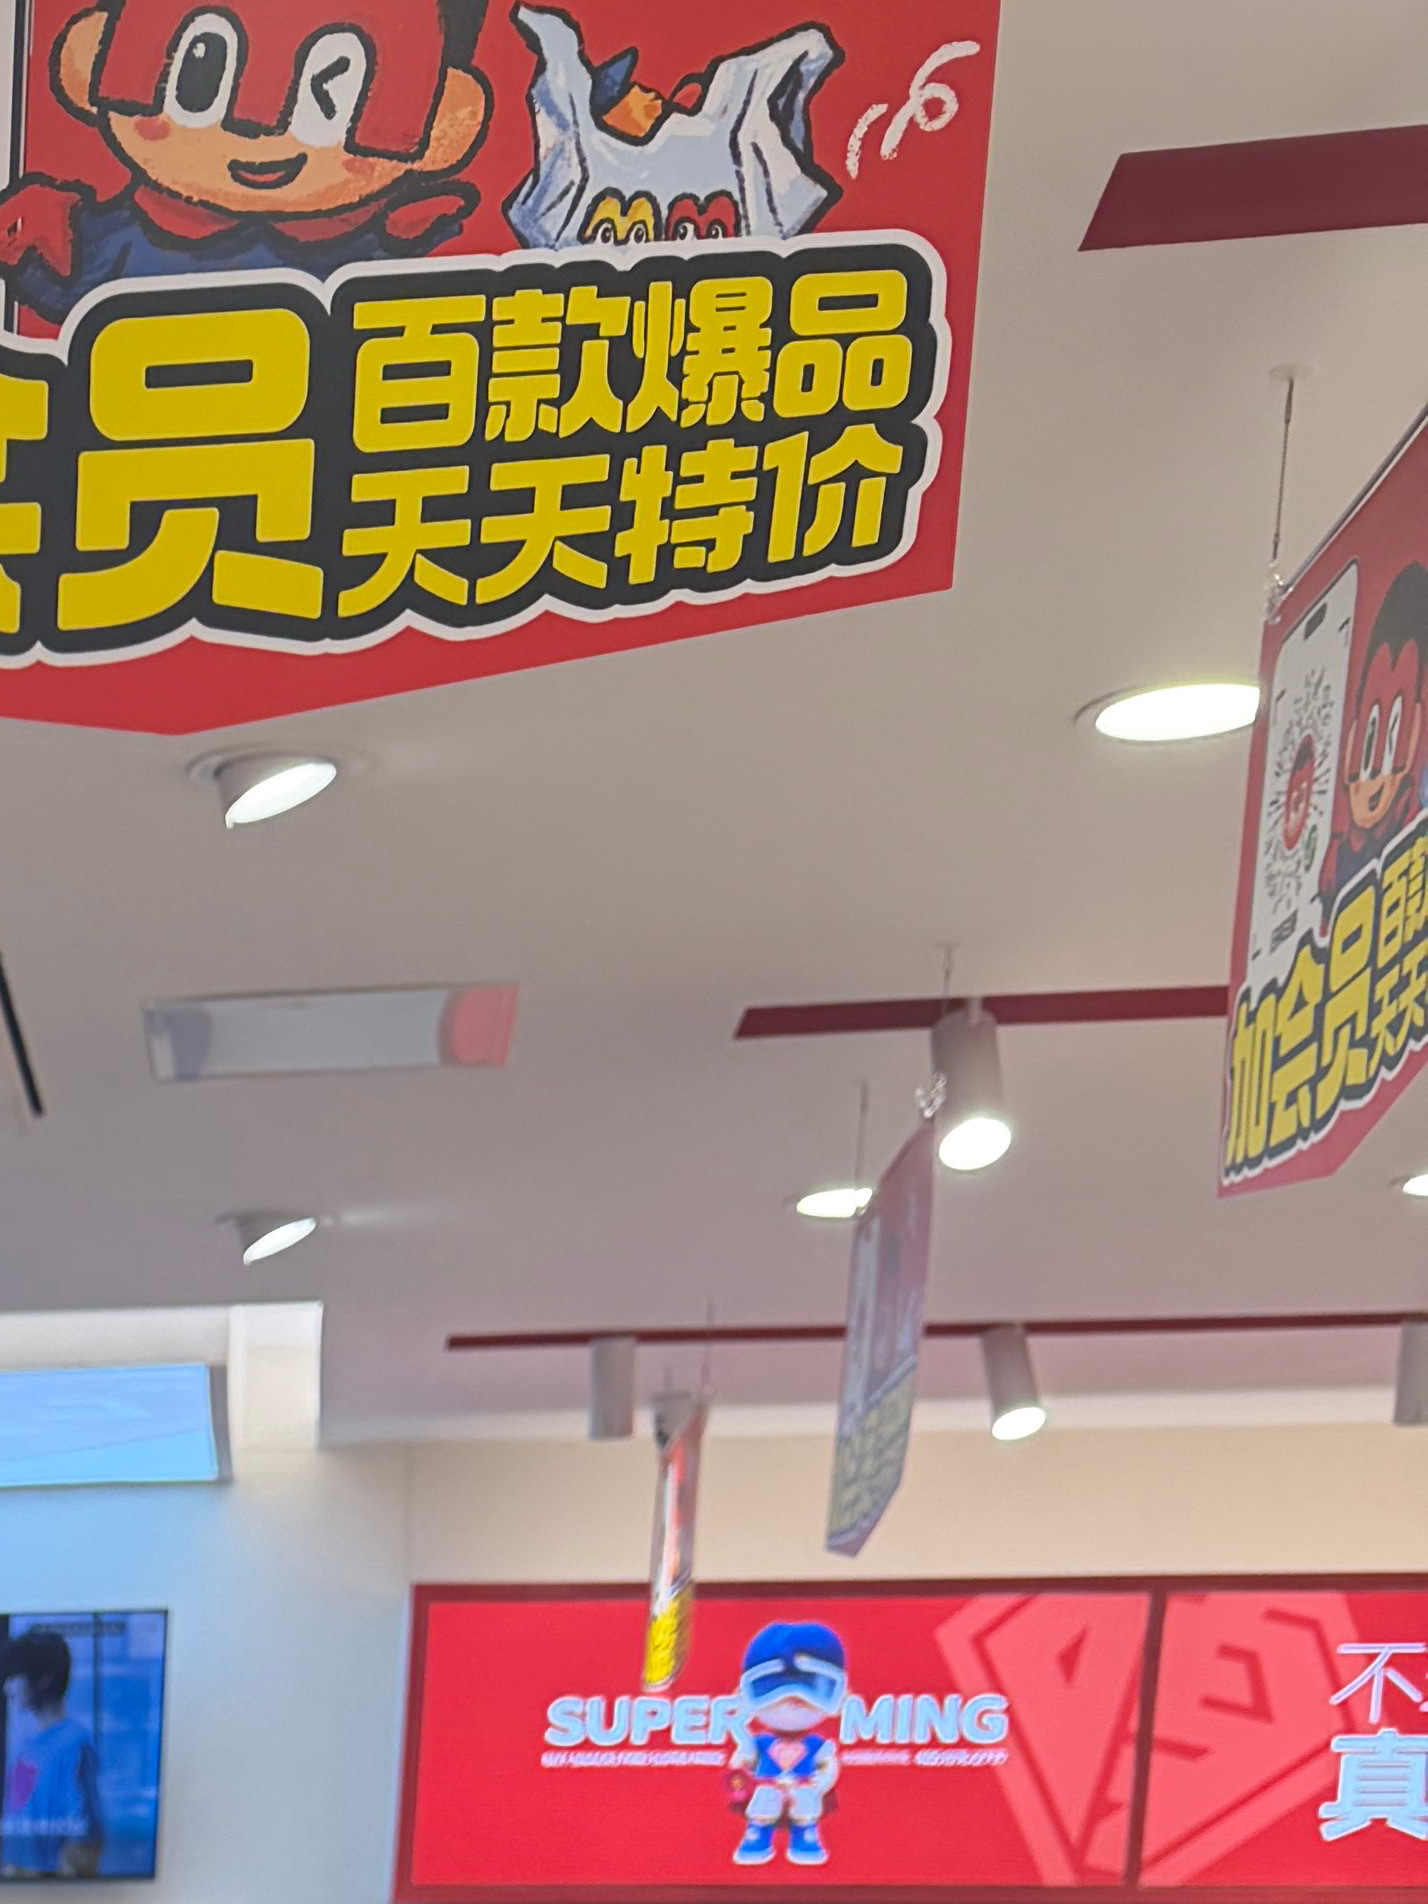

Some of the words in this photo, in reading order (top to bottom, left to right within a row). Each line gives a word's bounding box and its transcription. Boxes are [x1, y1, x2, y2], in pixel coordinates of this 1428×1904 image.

[353, 268, 912, 453] 百款爆品
[339, 430, 904, 618] 天天特价
[1226, 885, 1376, 1167] 加会员
[544, 1694, 746, 1747] SUPER
[838, 1694, 1010, 1745] MING
[1329, 1642, 1428, 1724] 不
